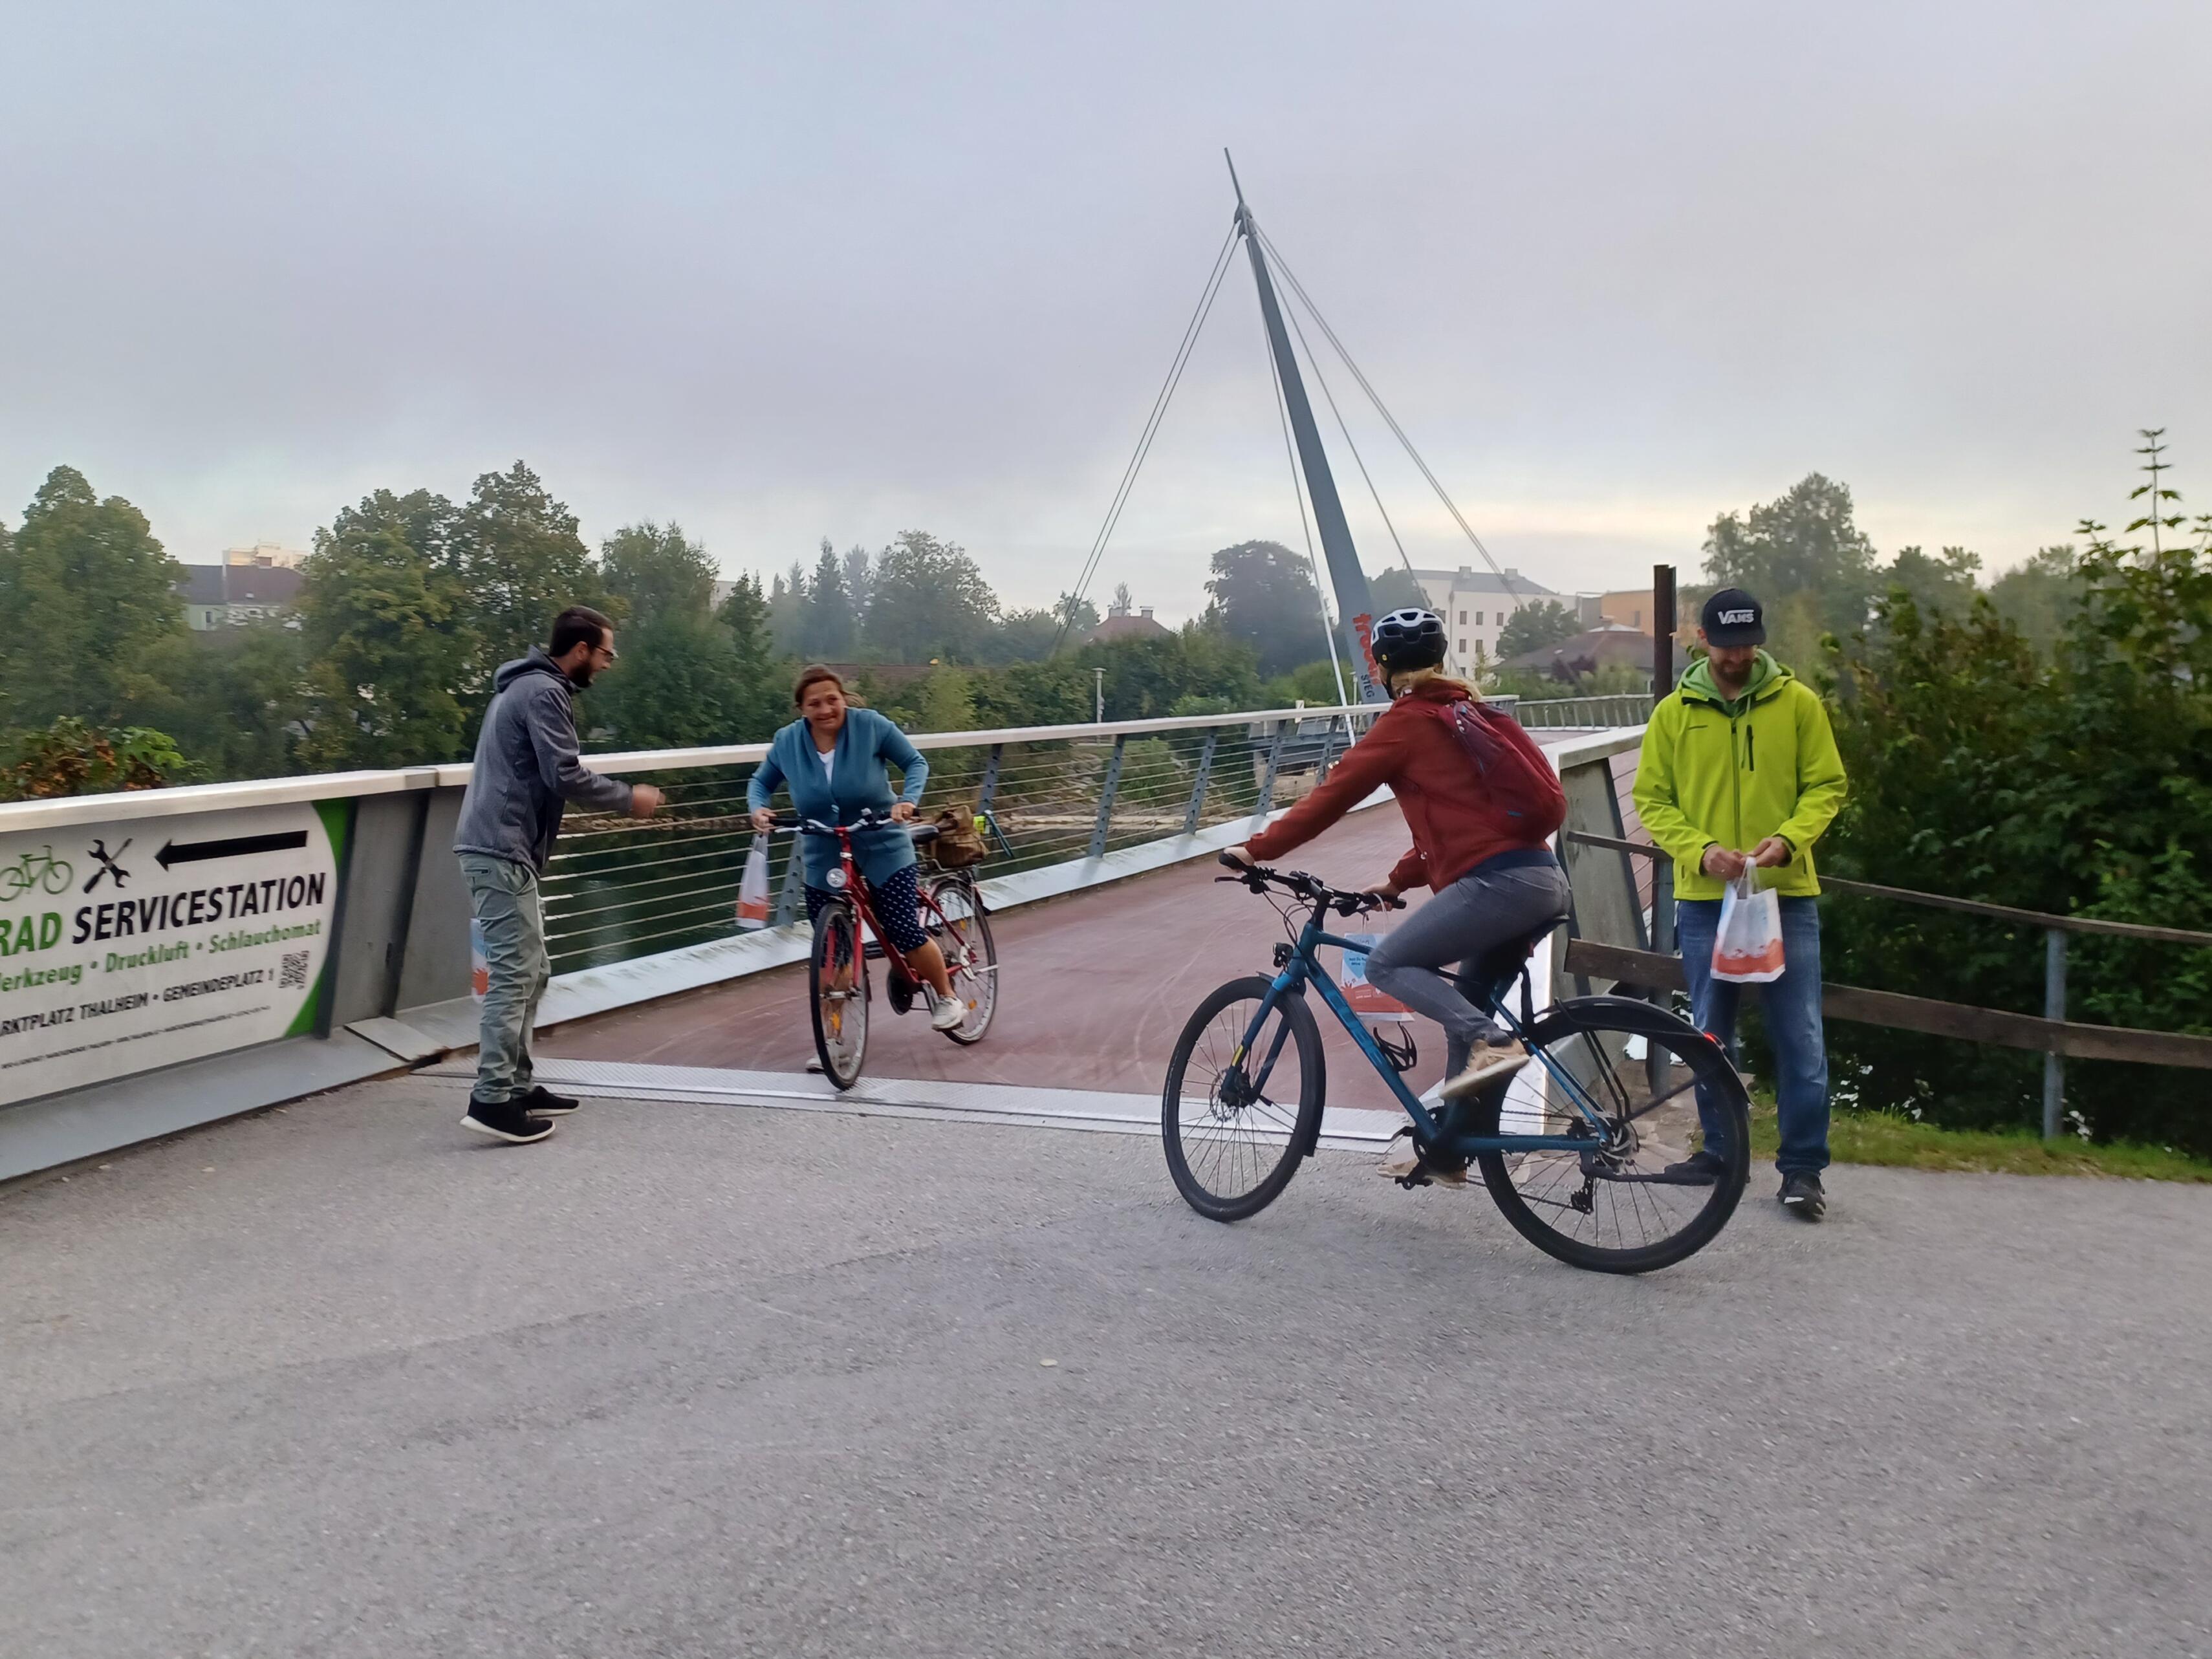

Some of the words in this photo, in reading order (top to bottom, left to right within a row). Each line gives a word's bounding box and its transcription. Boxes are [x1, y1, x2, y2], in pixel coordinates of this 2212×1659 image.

[1718, 609, 1754, 624] VANS
[1361, 675, 1374, 697] STEG
[0, 912, 62, 956] RAD
[72, 873, 326, 944] SERVICESTATION
[0, 964, 82, 992] erkzeug
[106, 940, 190, 973] Druckluft
[209, 919, 321, 953] Schlauchomat
[0, 1007, 74, 1035] RKTPLATZ
[80, 993, 149, 1019] THALHEIM
[163, 970, 264, 1002] GEMEINDEPLATZ
